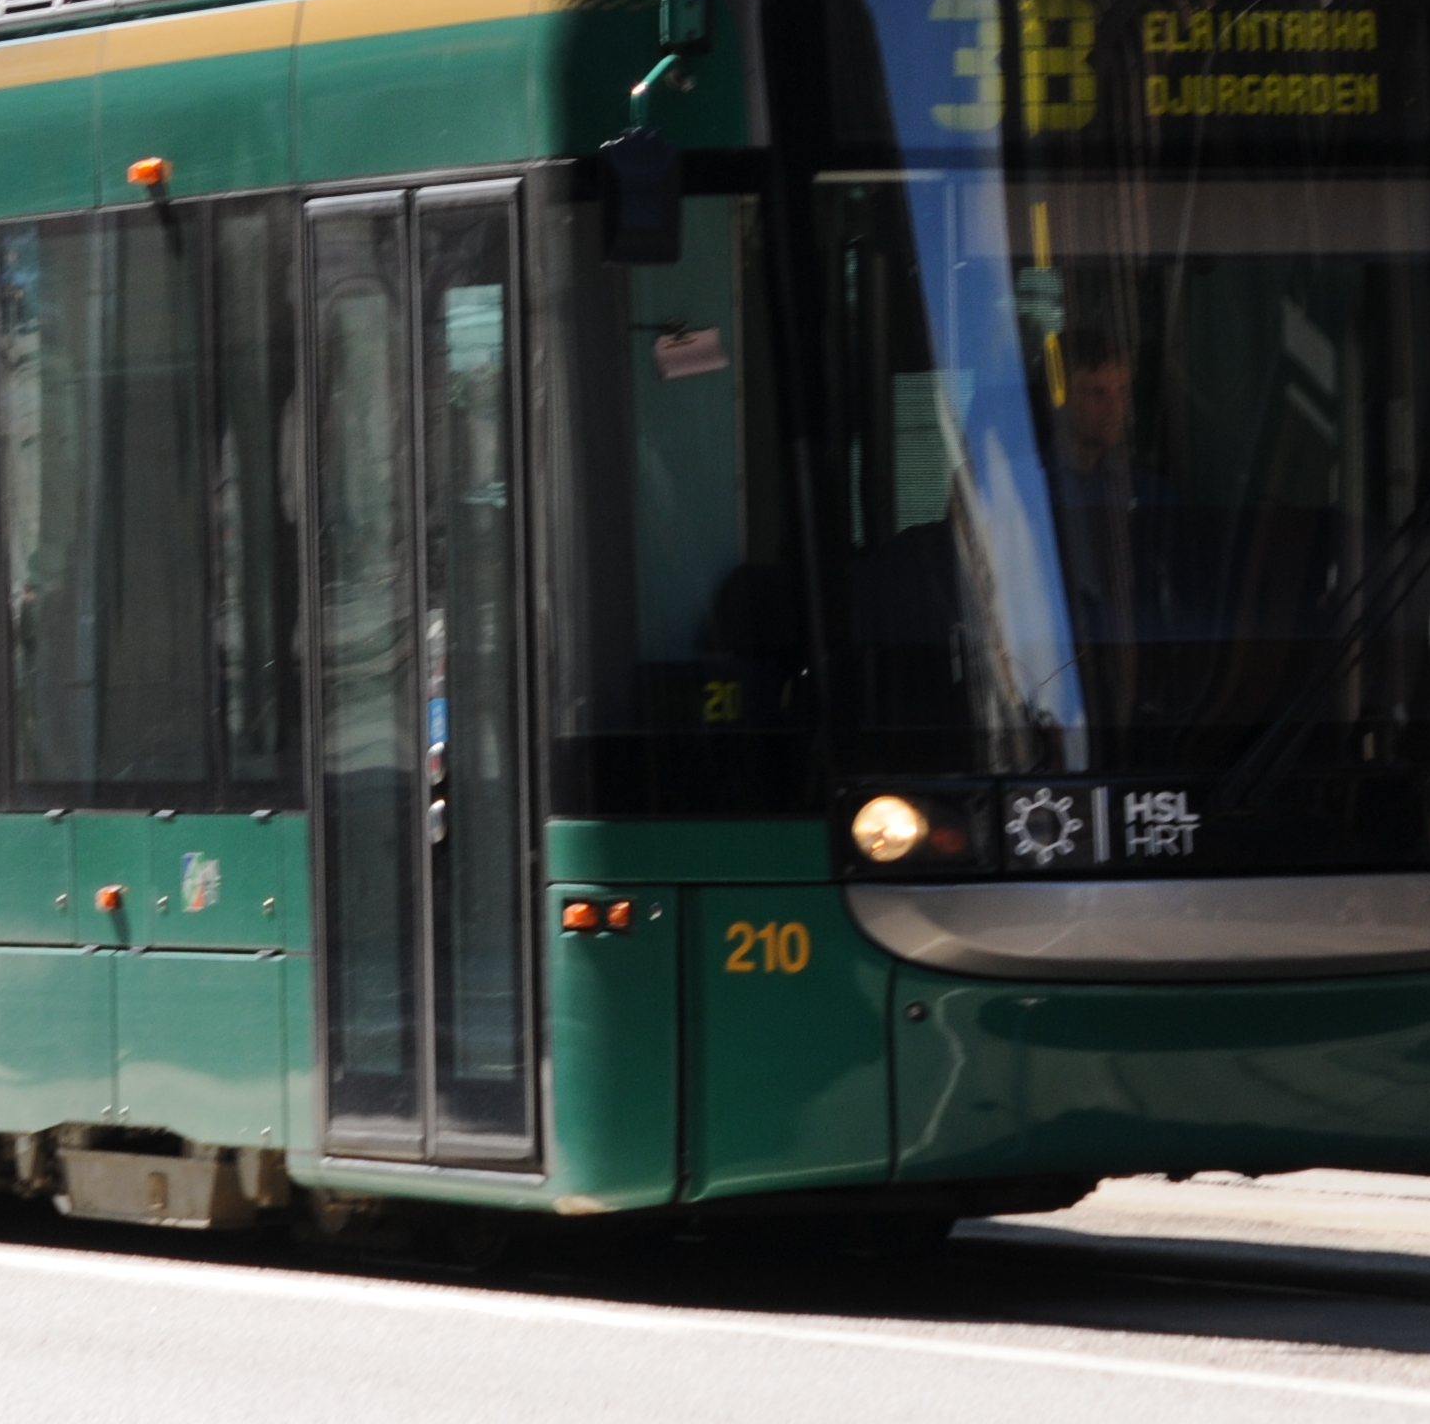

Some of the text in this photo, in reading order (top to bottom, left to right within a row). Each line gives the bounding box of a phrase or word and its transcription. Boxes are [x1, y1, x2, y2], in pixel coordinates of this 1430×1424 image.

[1123, 790, 1201, 825] HSL
[1124, 822, 1202, 858] HRT
[724, 920, 811, 973] 210
